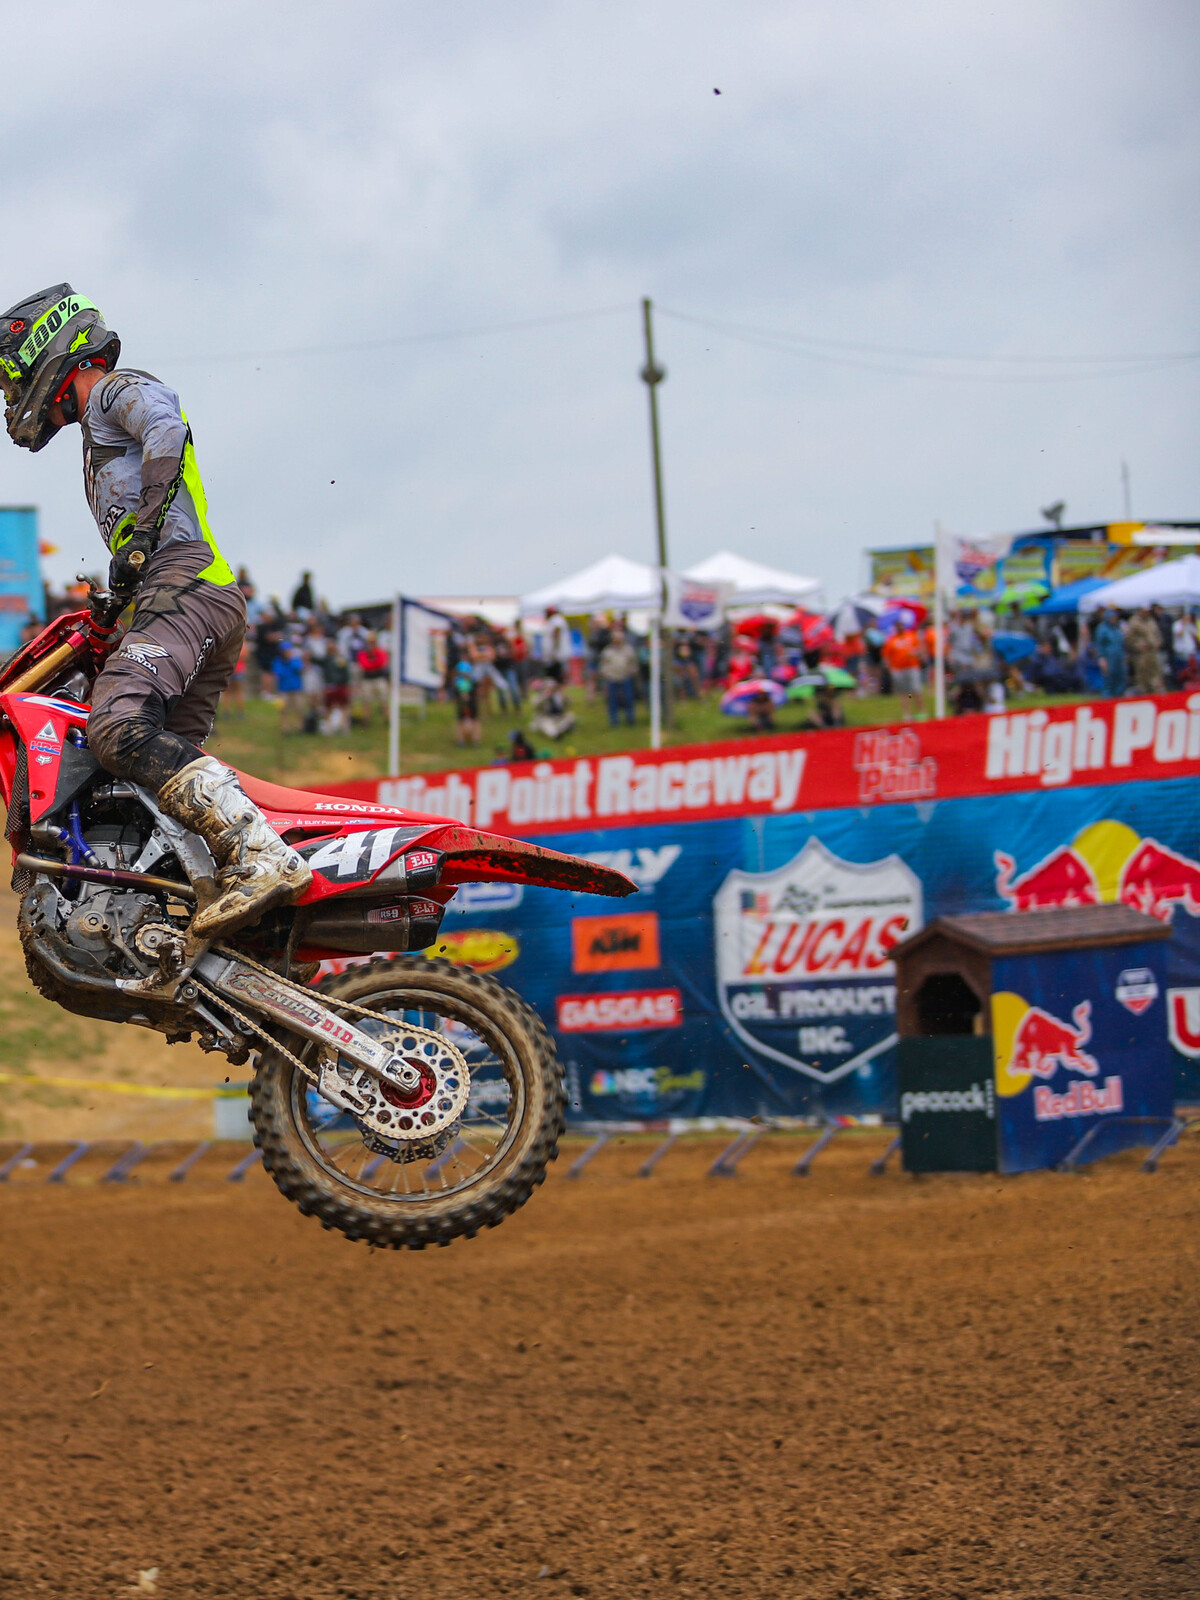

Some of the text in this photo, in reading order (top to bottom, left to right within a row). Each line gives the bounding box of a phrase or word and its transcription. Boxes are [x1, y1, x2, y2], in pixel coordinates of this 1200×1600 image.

[29, 293, 63, 322] ASTARS
[24, 297, 80, 360] 100%
[120, 652, 158, 676] HONDA
[30, 741, 62, 755] HRC
[855, 728, 937, 801] High Point
[986, 708, 1108, 786] High
[475, 759, 594, 828] Point
[597, 748, 806, 820] Raceway
[314, 803, 404, 815] HONDA
[308, 827, 402, 876] 41
[380, 908, 399, 918] RS-9
[743, 914, 909, 976] LUCAS
[560, 995, 678, 1028] GASGAS
[731, 992, 776, 1020] OIL
[798, 1025, 853, 1055] INC.
[901, 1083, 985, 1122] peacock
[1034, 1075, 1124, 1121] Red Bull
